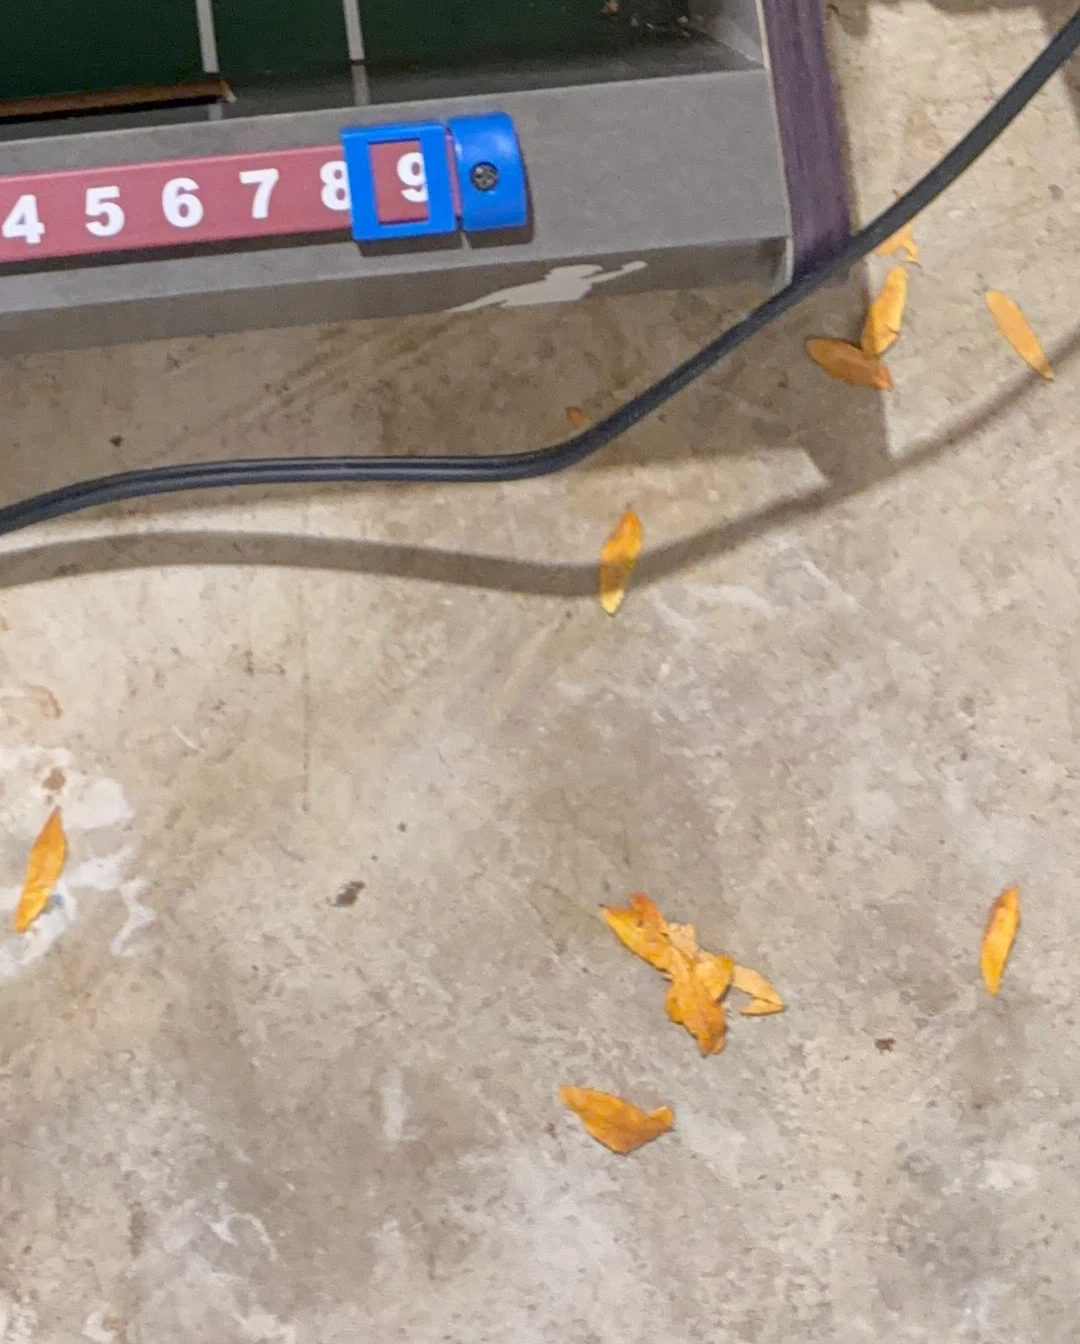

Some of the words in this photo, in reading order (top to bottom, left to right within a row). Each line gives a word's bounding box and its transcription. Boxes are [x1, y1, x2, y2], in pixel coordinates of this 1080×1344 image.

[1, 194, 46, 245] 4
[85, 185, 125, 237] 5
[161, 177, 204, 228] 6
[239, 167, 280, 219] 7
[319, 160, 353, 211] 8
[396, 151, 429, 203] 9
